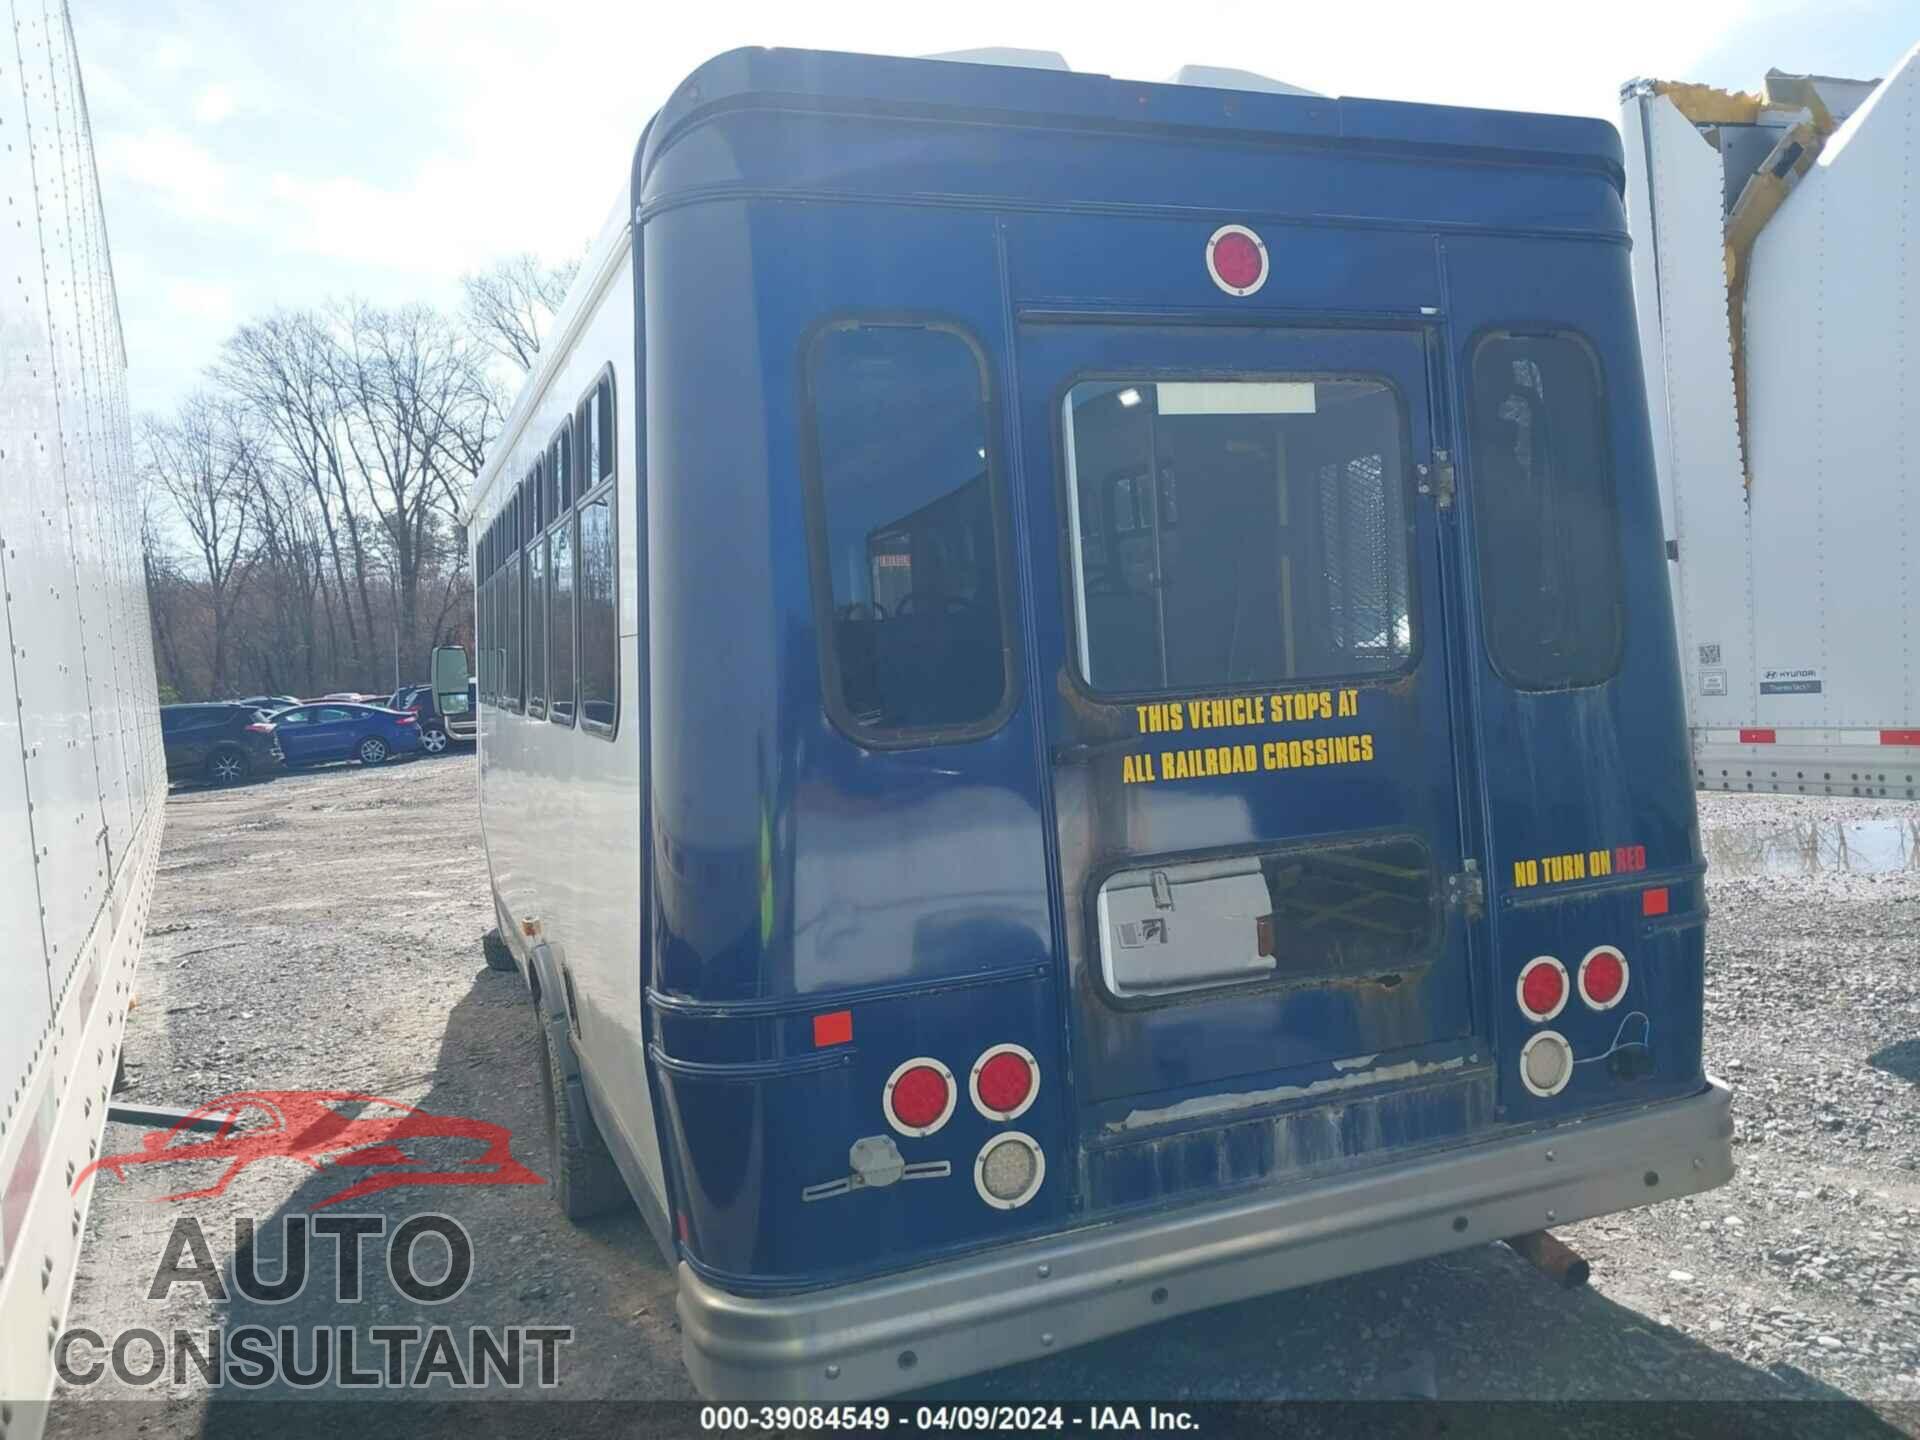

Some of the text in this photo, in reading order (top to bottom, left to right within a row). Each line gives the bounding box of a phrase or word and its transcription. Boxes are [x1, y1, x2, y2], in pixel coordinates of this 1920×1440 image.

[1136, 689, 1359, 734] THIS VEHICLE STOPS AT
[1122, 734, 1374, 784] ALL RAILROAD CROSSINGS
[1513, 845, 1646, 888] NO TURN ON RED
